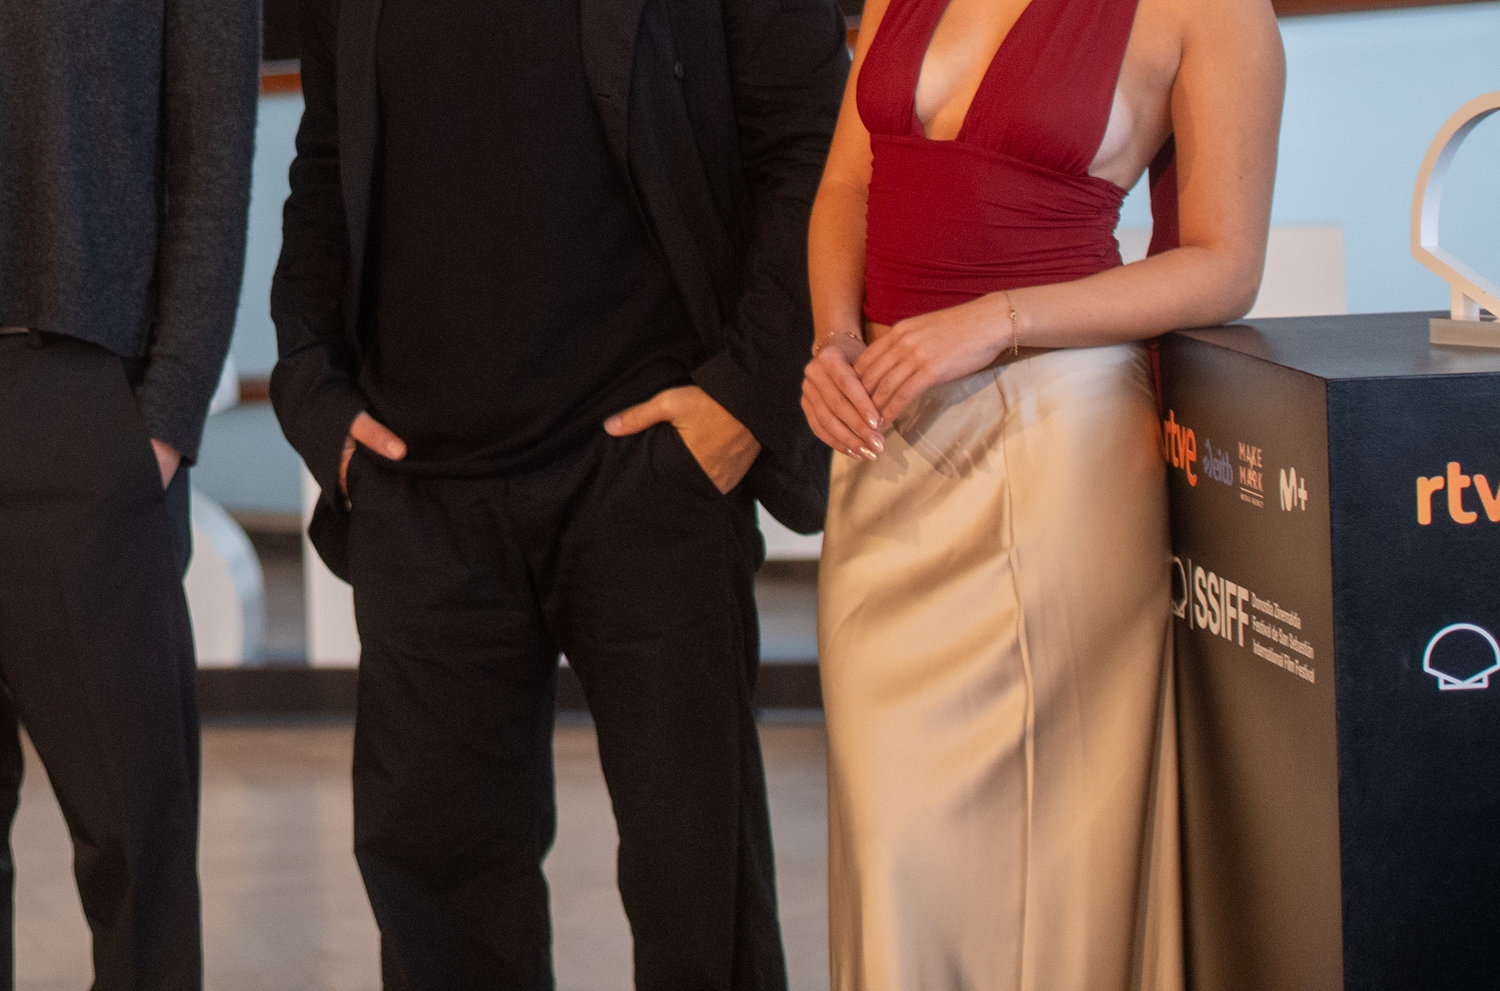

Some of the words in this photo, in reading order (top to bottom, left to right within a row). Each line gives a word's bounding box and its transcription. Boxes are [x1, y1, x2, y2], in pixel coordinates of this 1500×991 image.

[1163, 409, 1198, 487] rtve
[1238, 441, 1263, 468] MAKE
[1416, 461, 1500, 526] rtv
[1194, 565, 1249, 648] SSIFF
